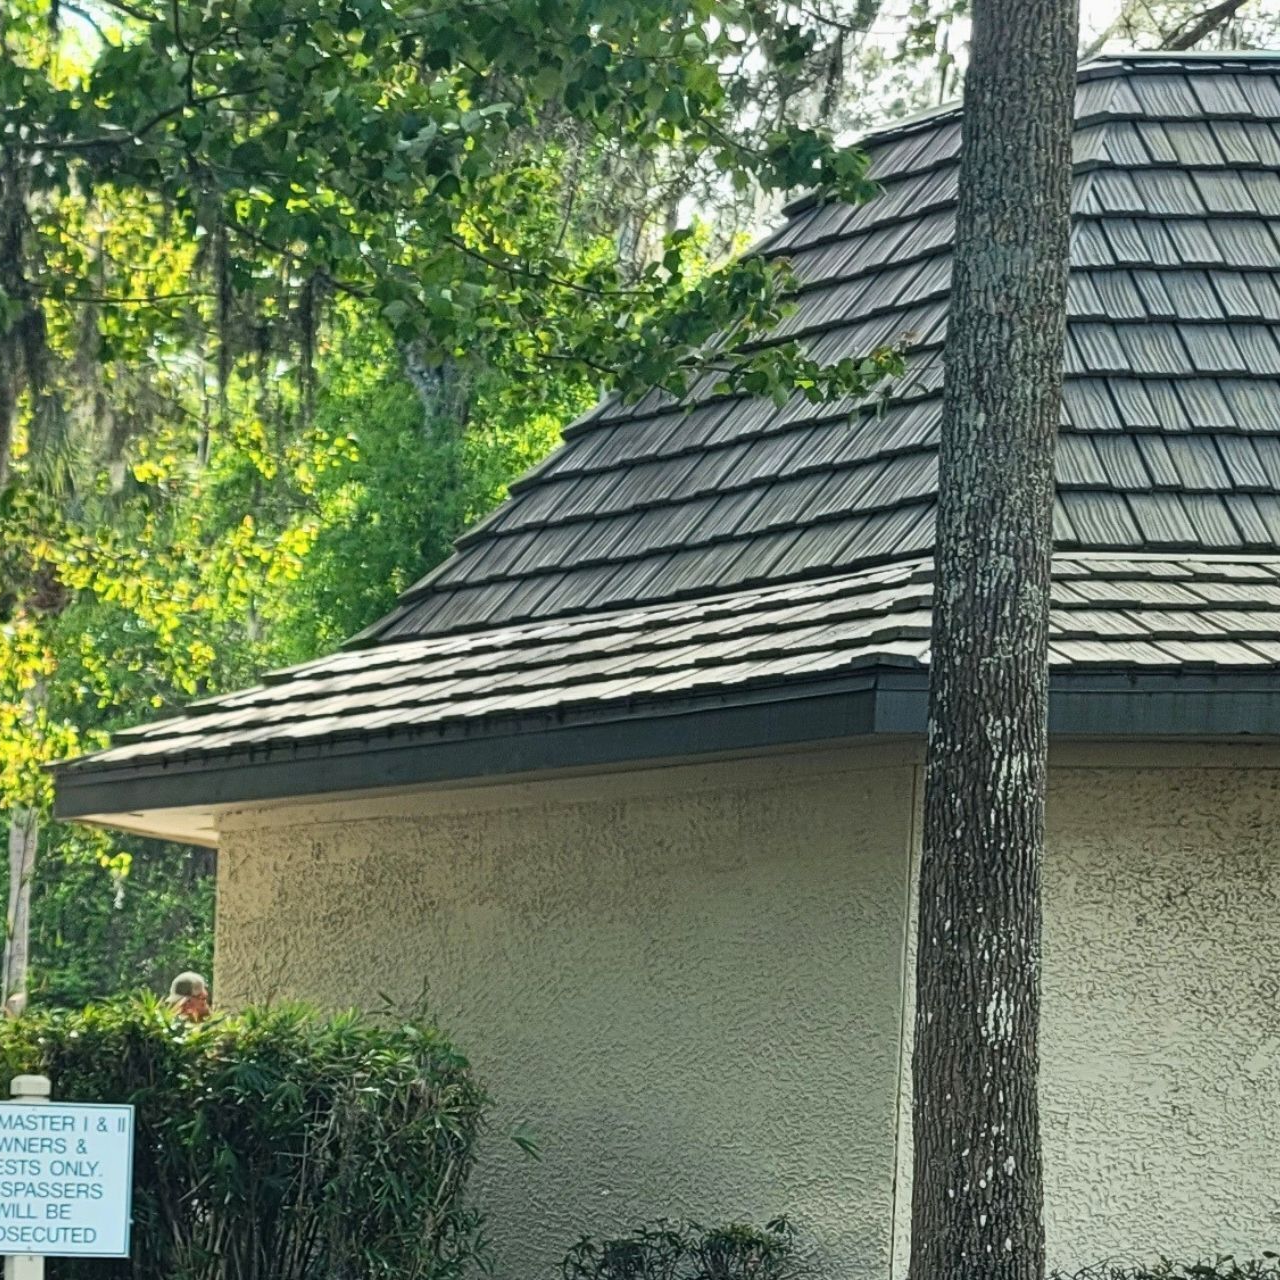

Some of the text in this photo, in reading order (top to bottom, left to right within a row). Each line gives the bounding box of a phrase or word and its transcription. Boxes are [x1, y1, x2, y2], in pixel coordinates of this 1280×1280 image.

[83, 1116, 88, 1132] I
[96, 1117, 108, 1133] &
[76, 1138, 88, 1154] &
[49, 1160, 103, 1177] ONLY.
[46, 1204, 72, 1219] BE
